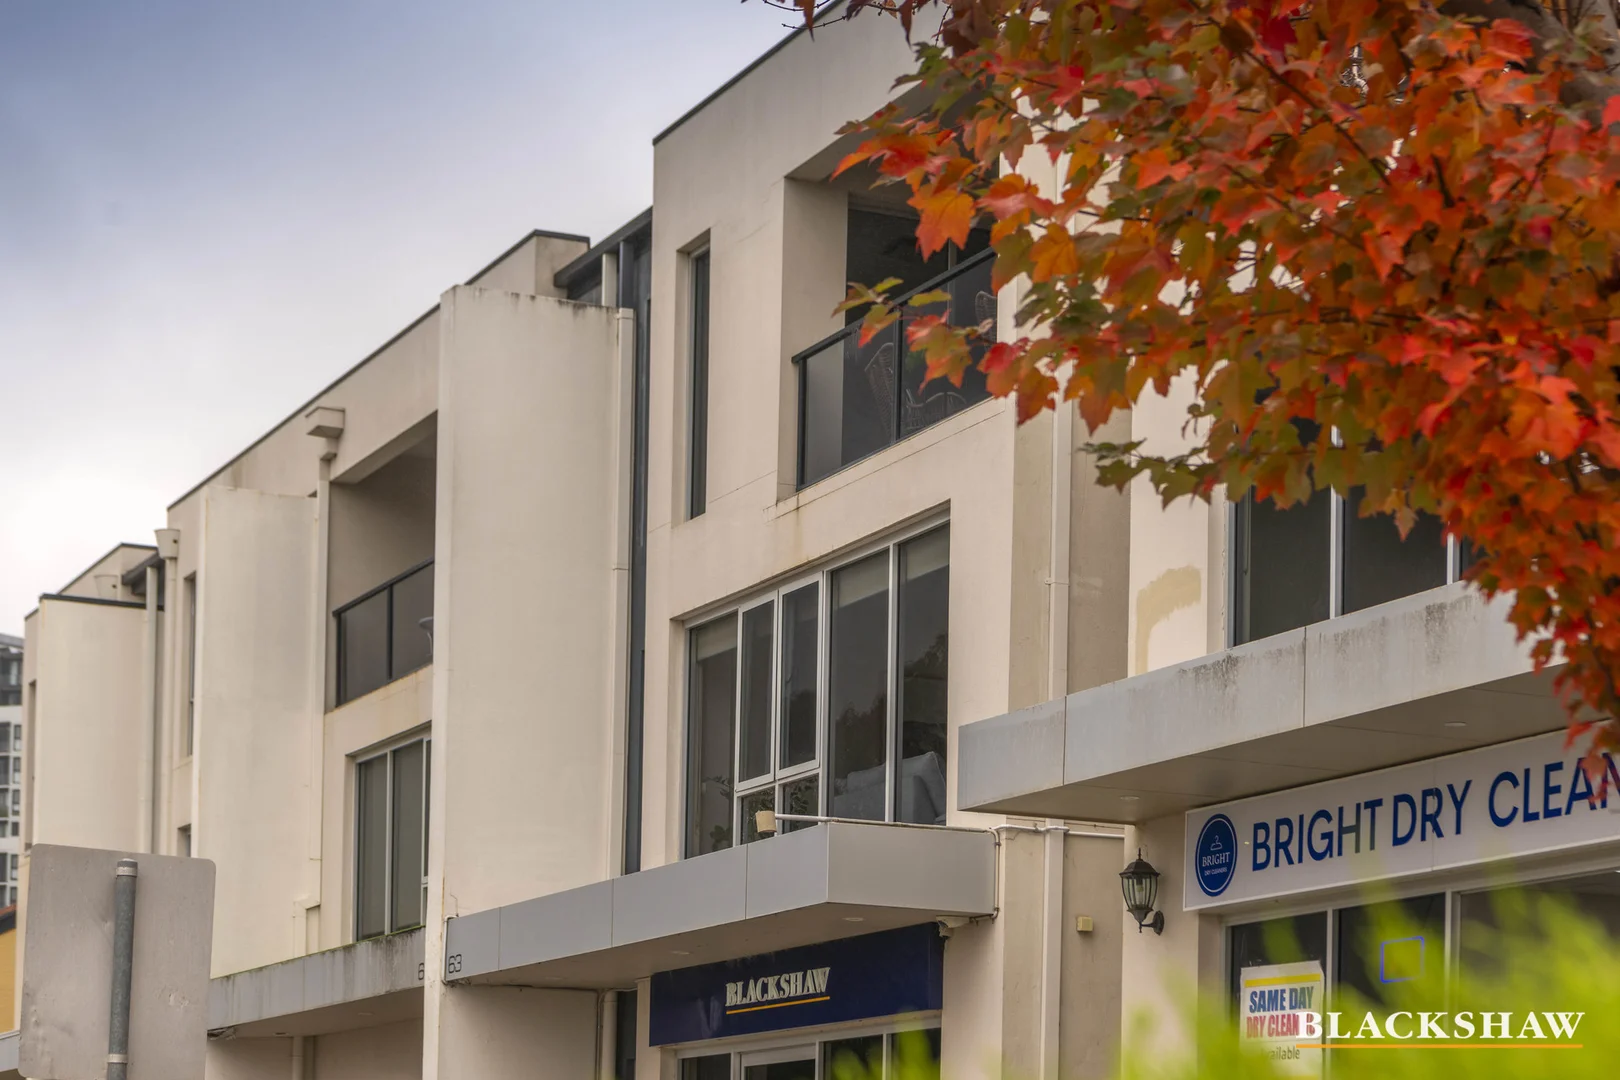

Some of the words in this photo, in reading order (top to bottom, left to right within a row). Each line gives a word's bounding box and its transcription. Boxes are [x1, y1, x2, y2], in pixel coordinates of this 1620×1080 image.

[1252, 798, 1383, 872] BRIGHT
[1392, 779, 1473, 847] DRY
[1202, 851, 1231, 867] BRIGHT
[447, 953, 462, 974] 63
[725, 967, 831, 1007] BLACKSHAW
[1249, 988, 1286, 1013] SAME
[1289, 986, 1314, 1010] DAY
[1246, 1015, 1266, 1039] DRY
